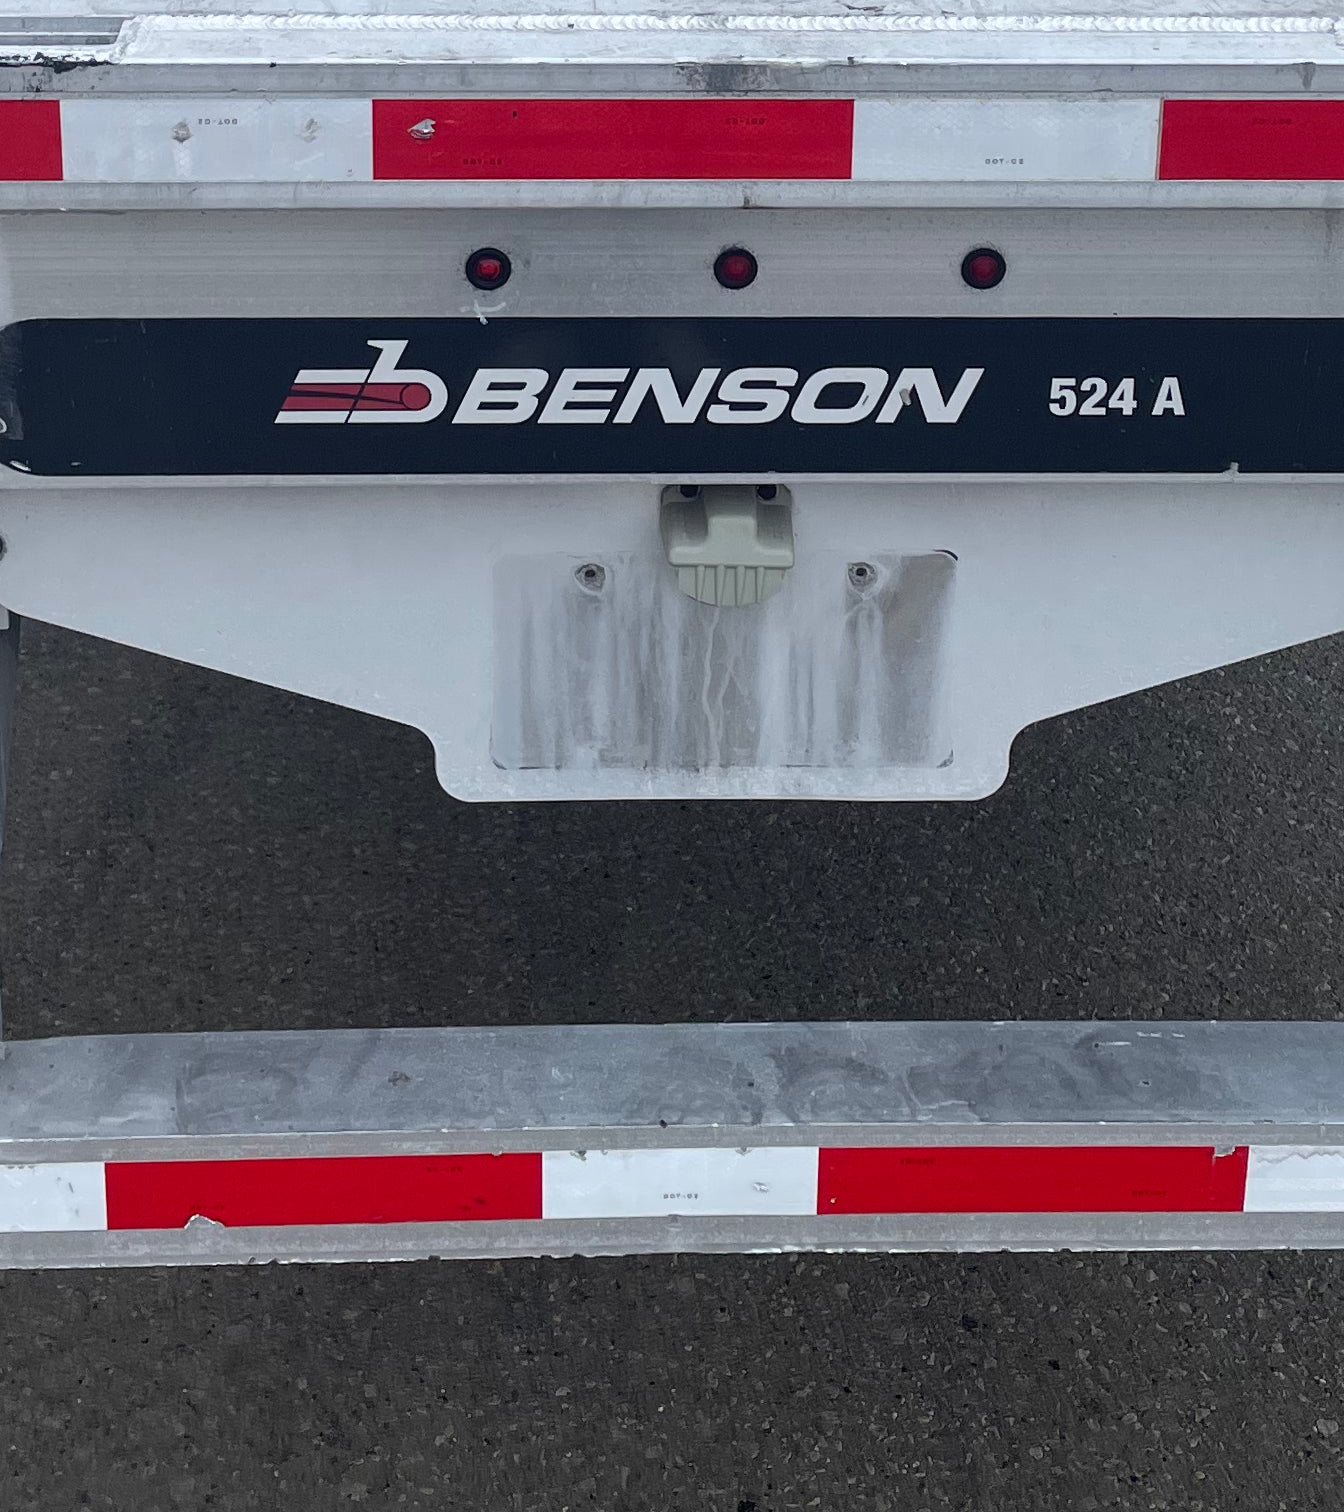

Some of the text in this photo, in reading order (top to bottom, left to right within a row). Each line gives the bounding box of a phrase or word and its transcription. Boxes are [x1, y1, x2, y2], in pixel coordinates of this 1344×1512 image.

[452, 367, 985, 424] BENSON
[1048, 377, 1138, 416] 524
[1151, 376, 1186, 416] A
